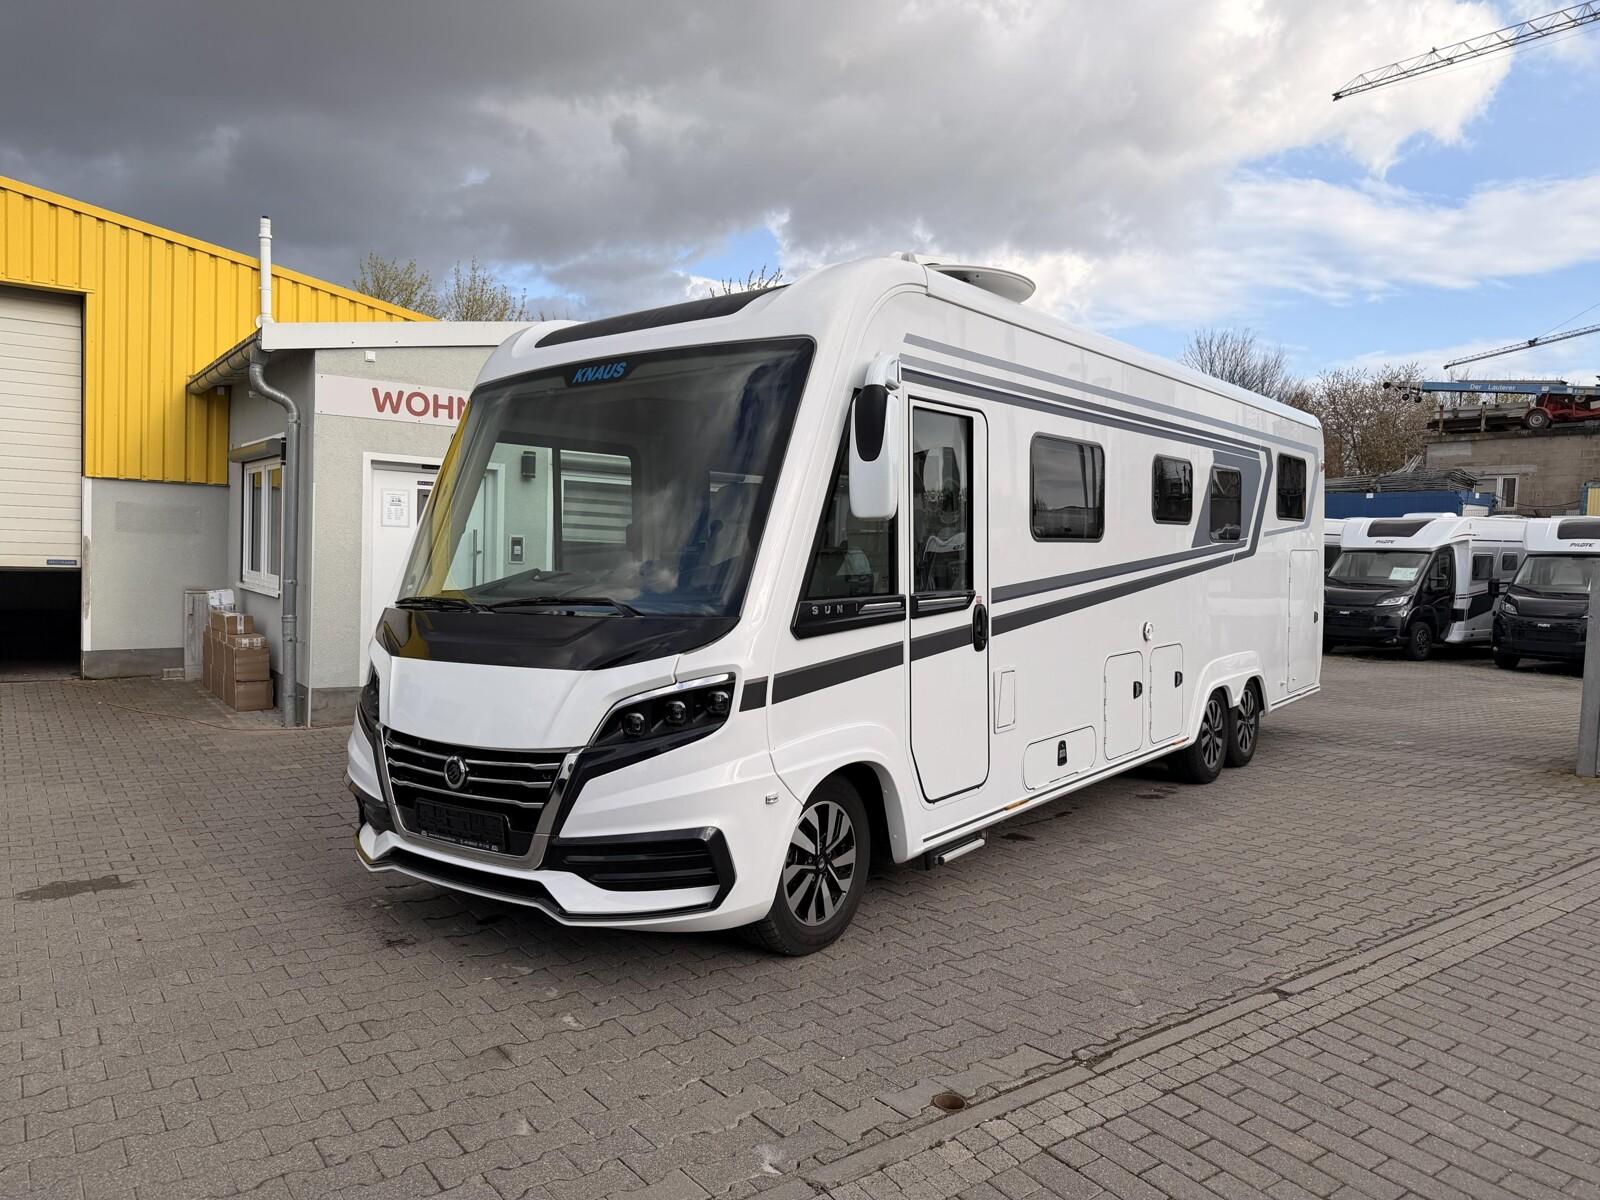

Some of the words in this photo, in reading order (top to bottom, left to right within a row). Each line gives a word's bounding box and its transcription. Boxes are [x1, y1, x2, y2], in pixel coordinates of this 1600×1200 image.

[571, 361, 627, 385] KNAUS
[1487, 383, 1517, 391] Lauterer
[811, 604, 844, 615] SUN
